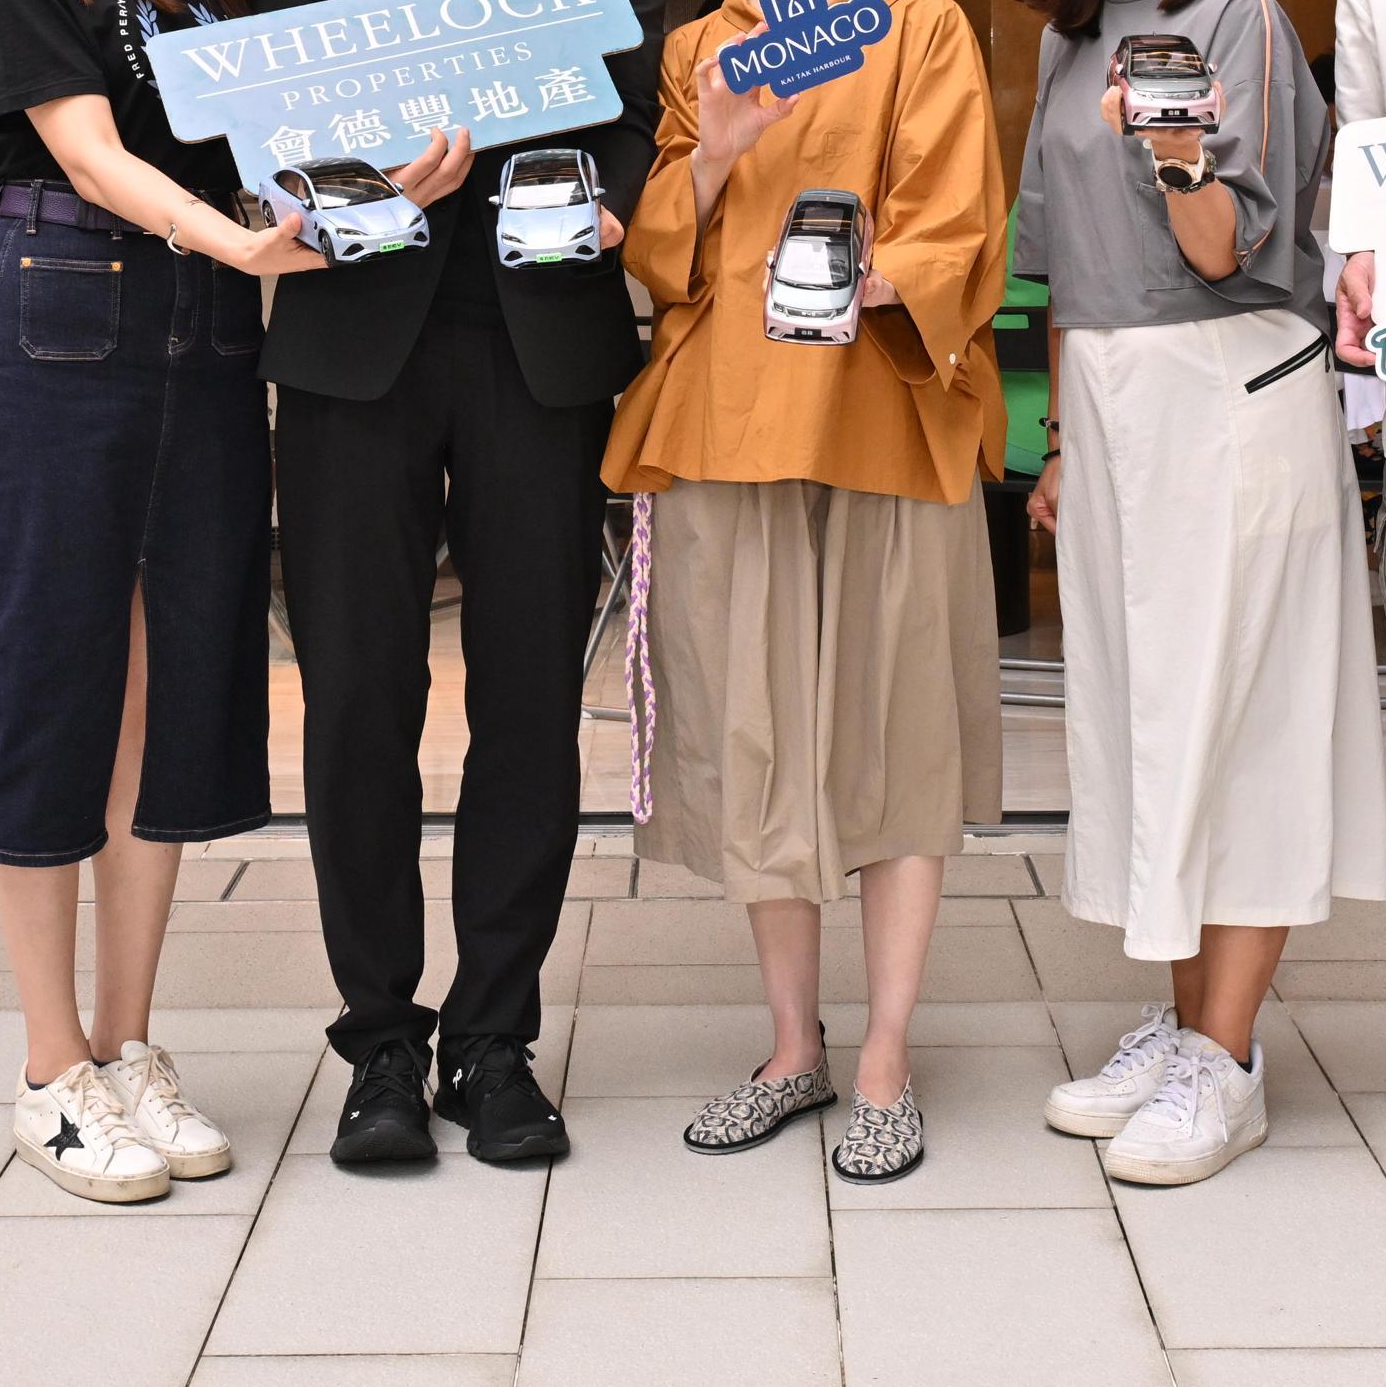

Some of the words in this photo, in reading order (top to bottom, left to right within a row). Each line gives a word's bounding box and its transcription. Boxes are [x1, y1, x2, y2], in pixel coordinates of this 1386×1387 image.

[124, 44, 145, 79] FRED
[280, 41, 535, 111] PROPERTIES
[730, 6, 880, 82] MONACO
[780, 75, 795, 86] KAI
[797, 70, 812, 80] TAK
[813, 54, 852, 75] HARBOUR
[261, 66, 596, 169] 會德豐地產
